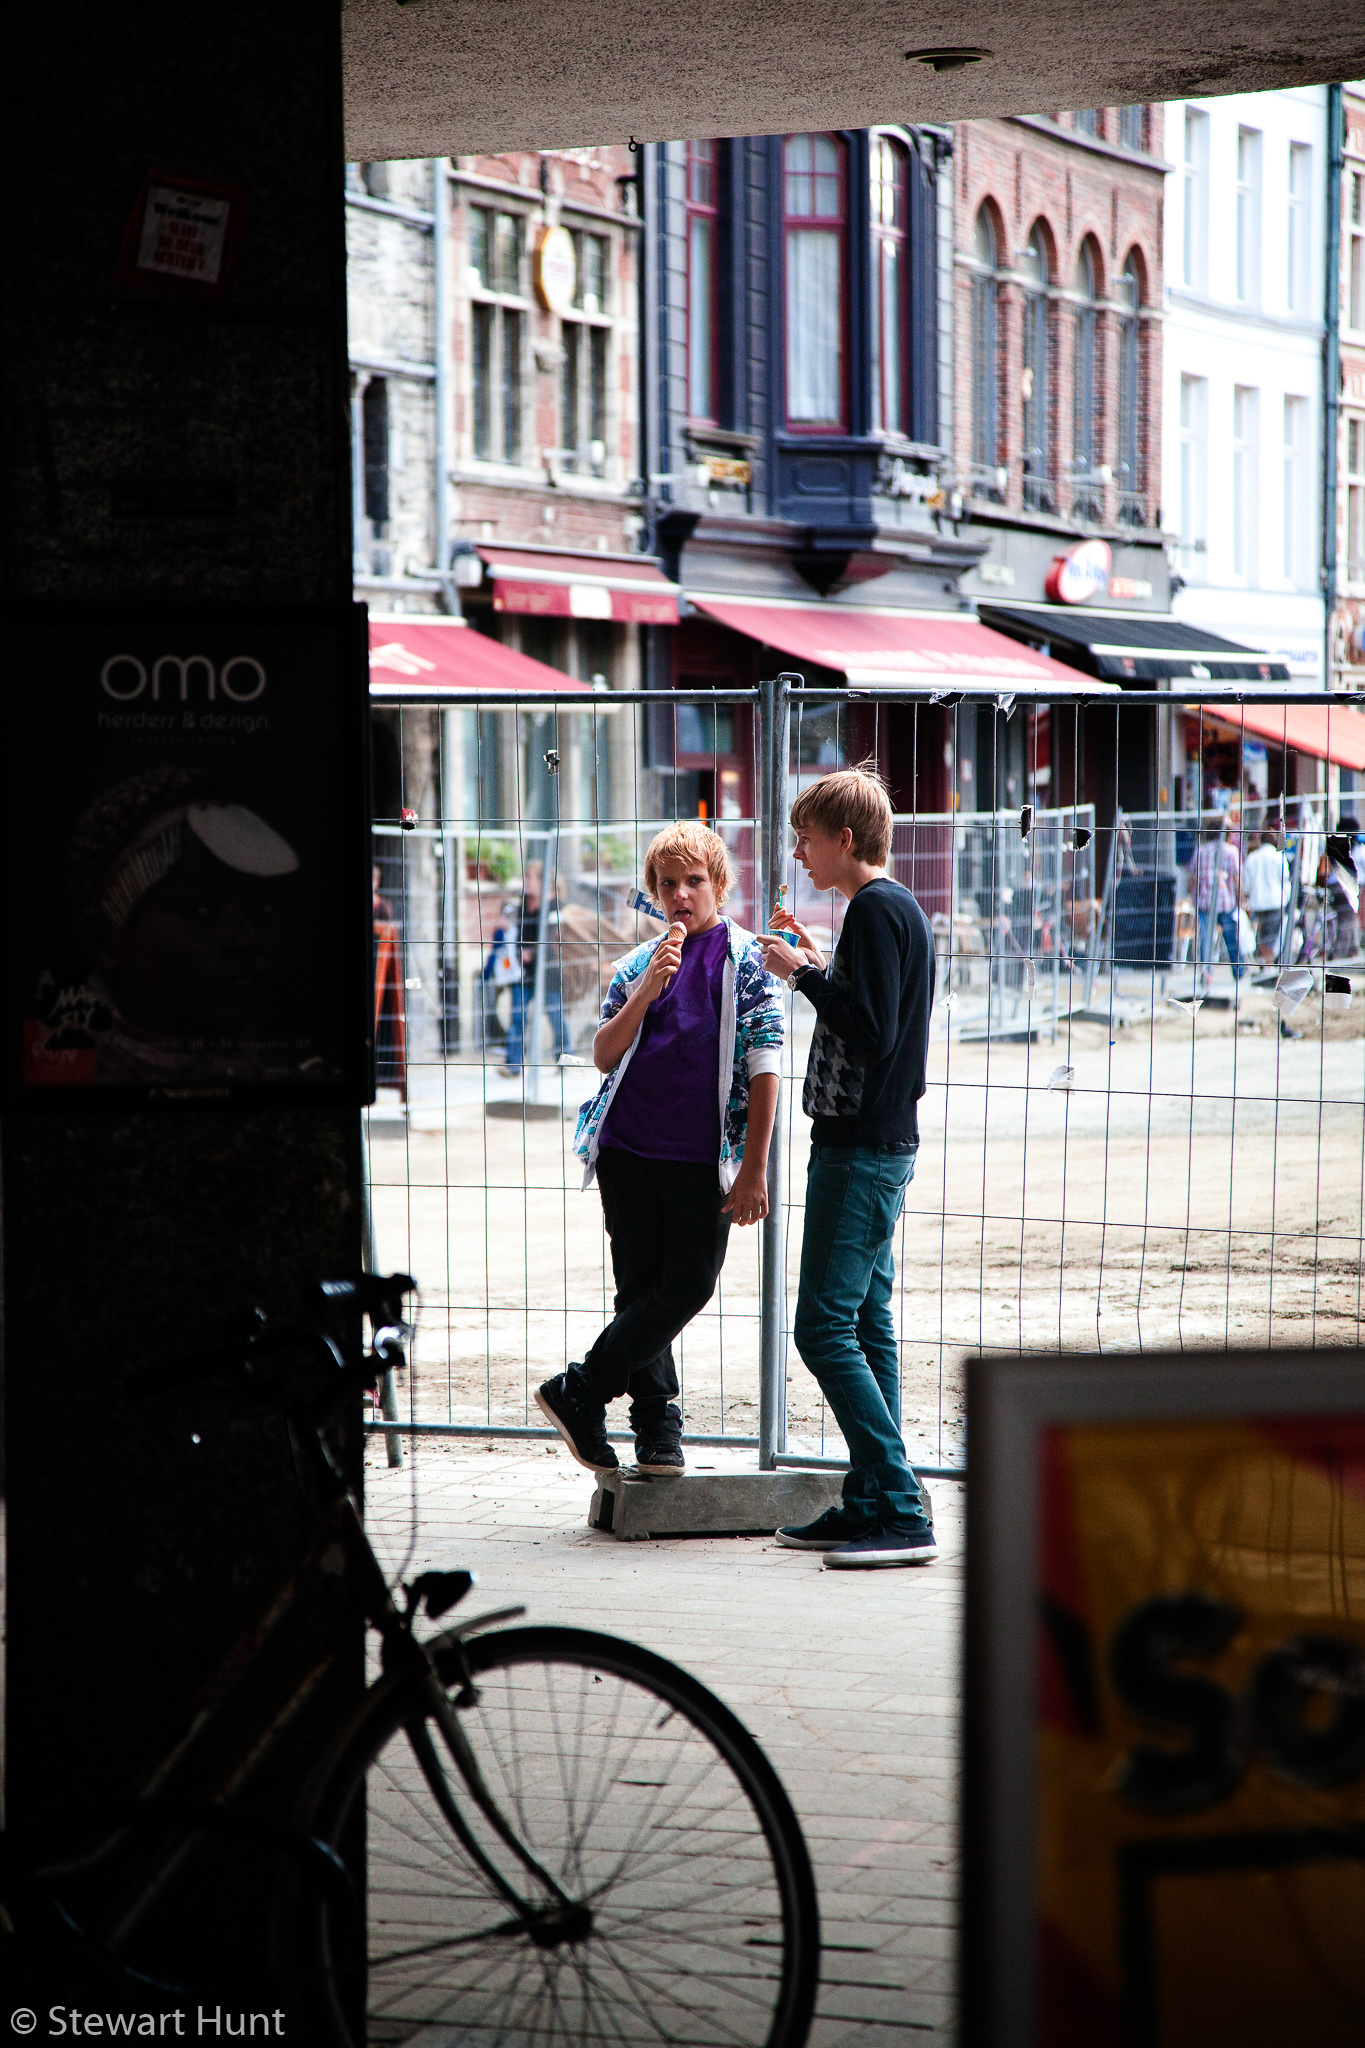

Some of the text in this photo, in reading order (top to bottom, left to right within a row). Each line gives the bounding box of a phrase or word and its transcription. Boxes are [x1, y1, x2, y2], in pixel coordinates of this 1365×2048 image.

[97, 709, 271, 734] herders & design
